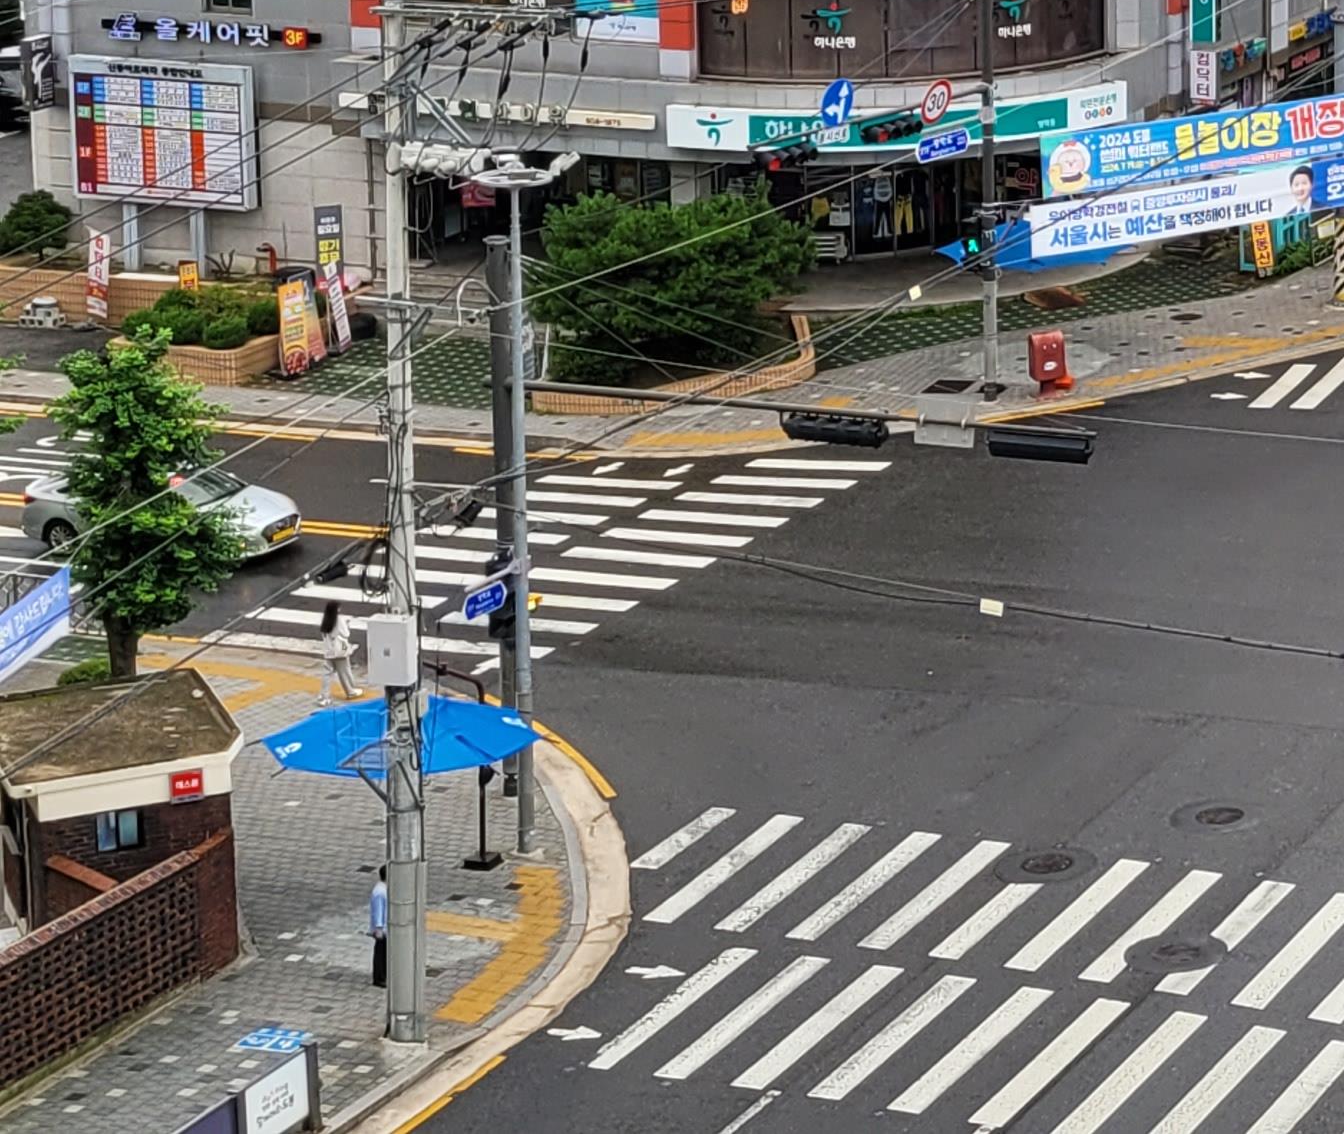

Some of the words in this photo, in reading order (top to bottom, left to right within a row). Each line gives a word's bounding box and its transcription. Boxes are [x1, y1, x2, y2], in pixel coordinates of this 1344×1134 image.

[155, 18, 270, 47] 올케어핏
[285, 29, 304, 46] 3F
[997, 23, 1032, 39] 하나은행
[813, 35, 857, 49] 하나은행
[926, 90, 947, 115] 30
[1098, 131, 1132, 148] 2024
[1174, 110, 1282, 162] 물놀이장
[1050, 221, 1121, 247] 서울시는
[1125, 213, 1177, 237] 예산을
[1180, 205, 1231, 226] 책정해야
[1234, 198, 1273, 218] 합니다
